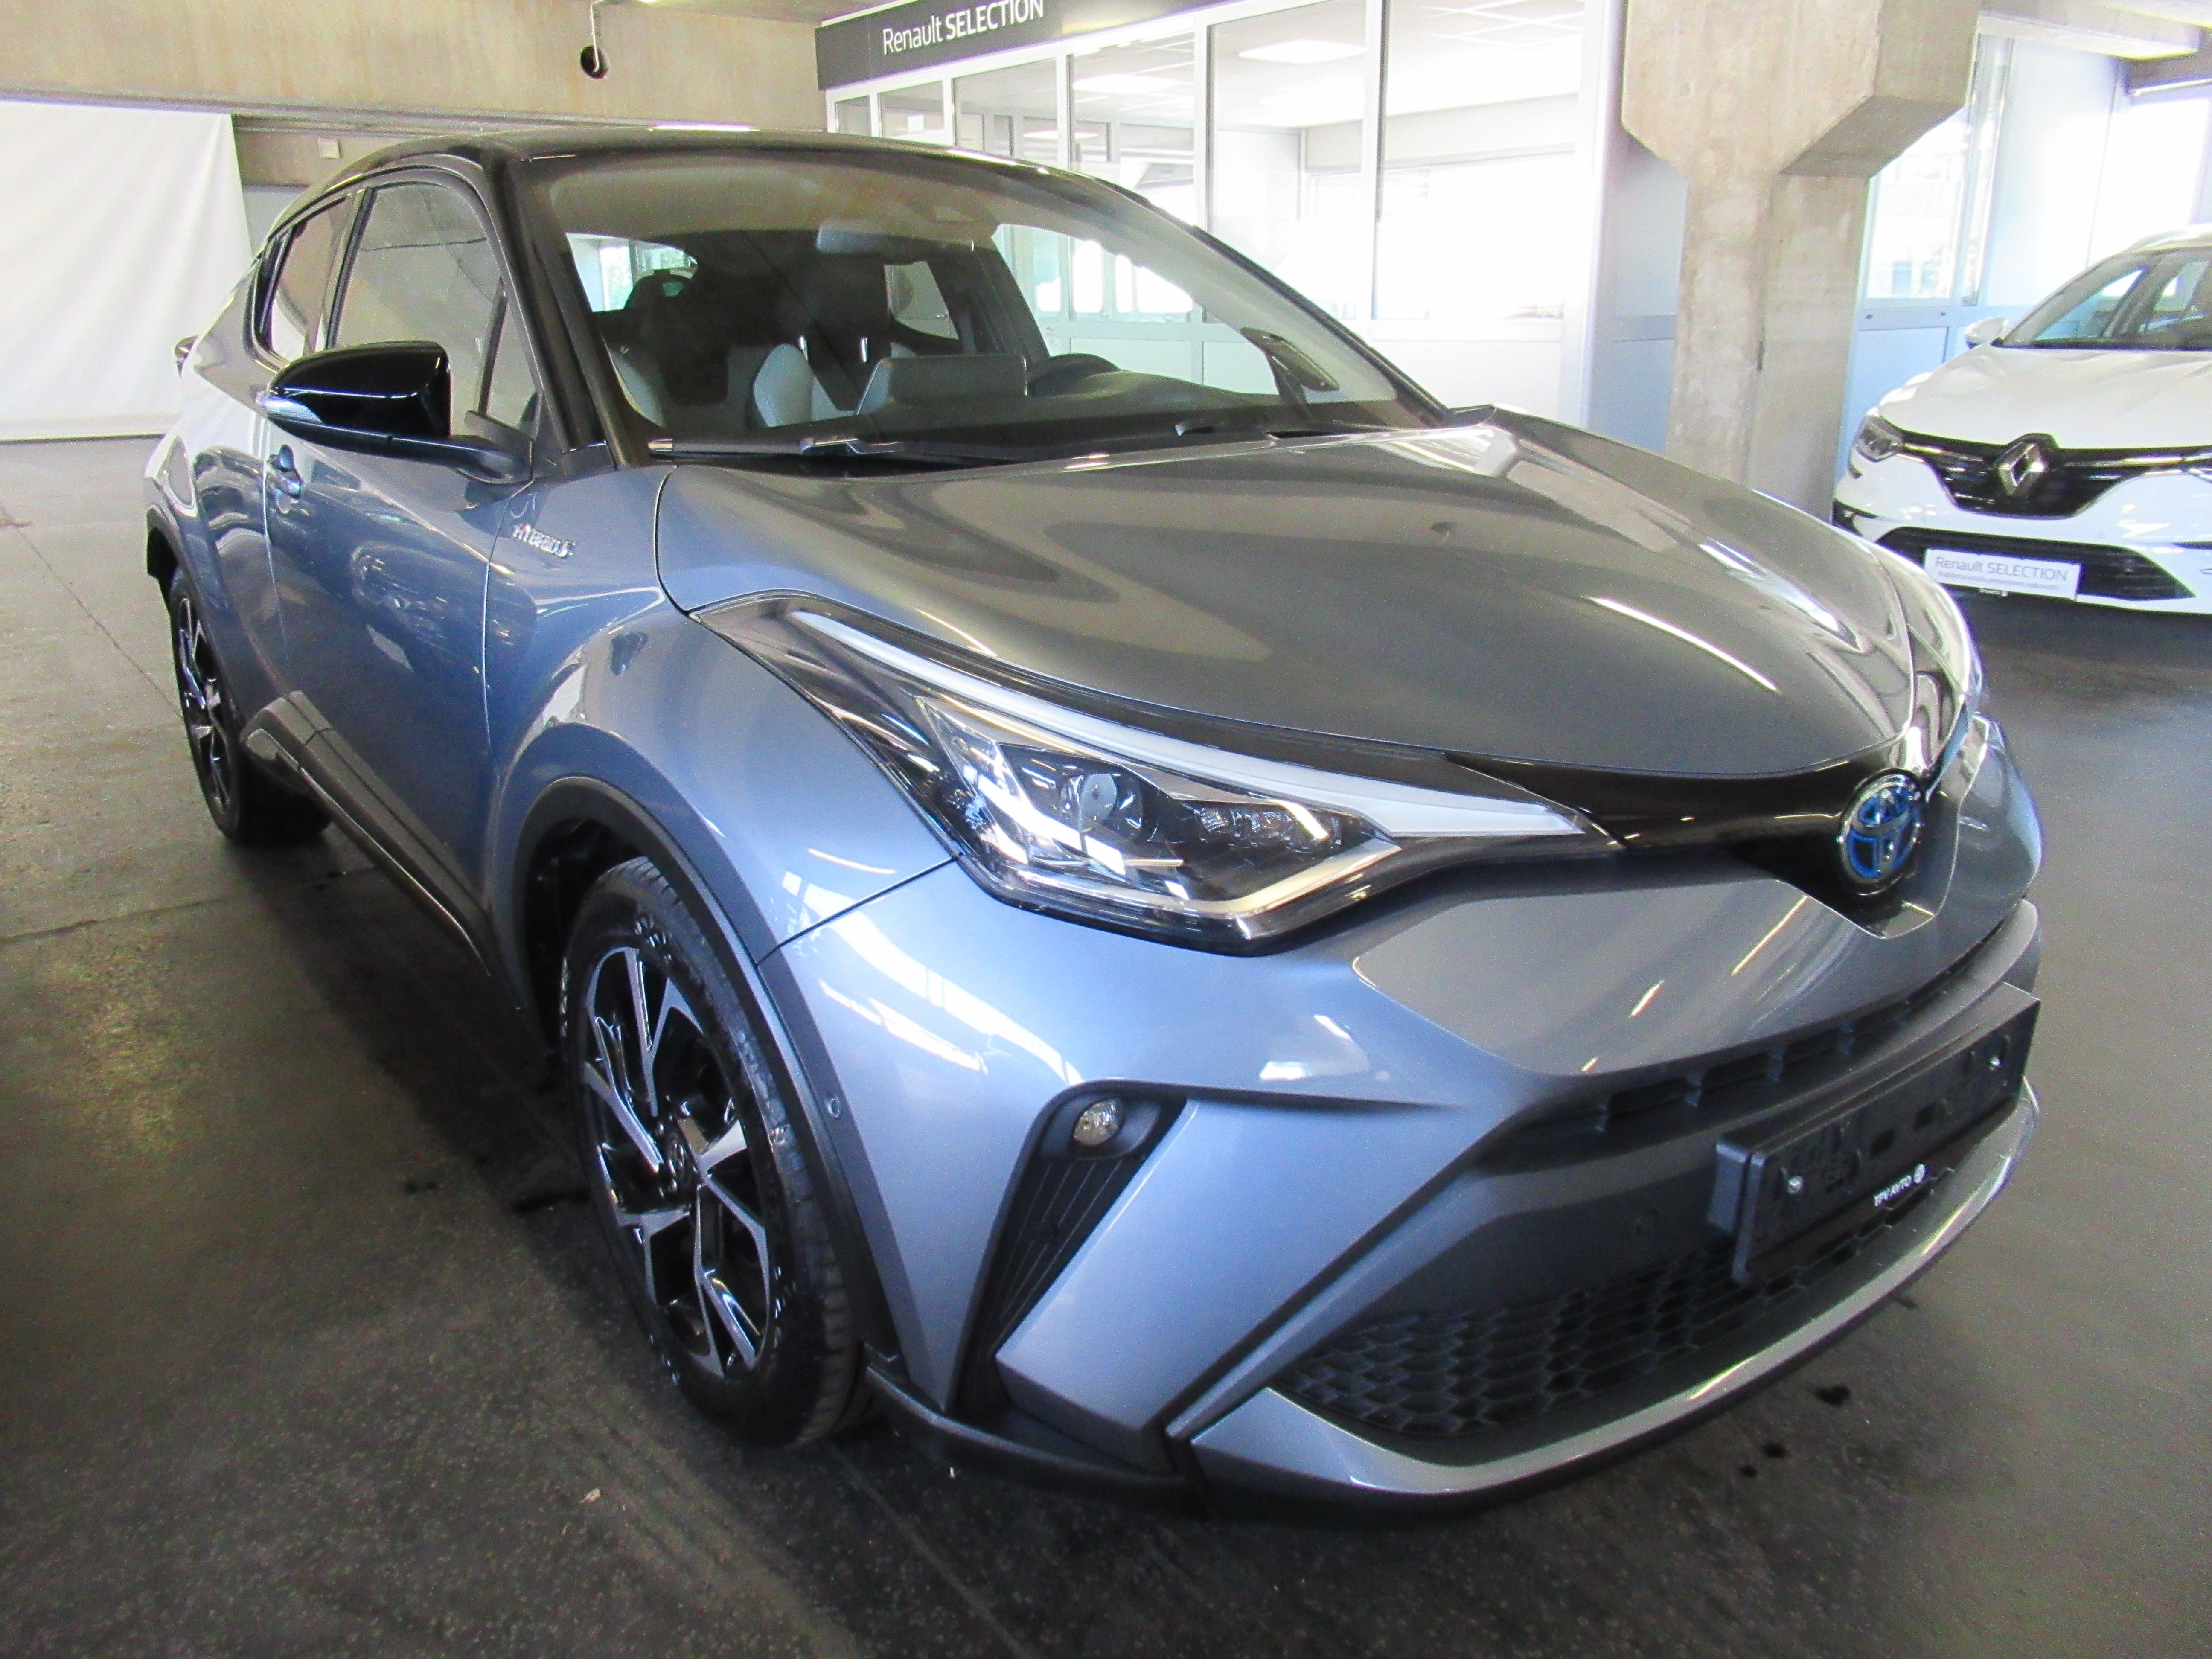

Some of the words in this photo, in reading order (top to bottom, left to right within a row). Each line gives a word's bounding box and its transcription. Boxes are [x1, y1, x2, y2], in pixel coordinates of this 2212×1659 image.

[883, 15, 943, 55] Renault
[945, 0, 1044, 40] SELECTION
[1936, 556, 1983, 573] Renault
[1987, 562, 2068, 582] SELECTION
